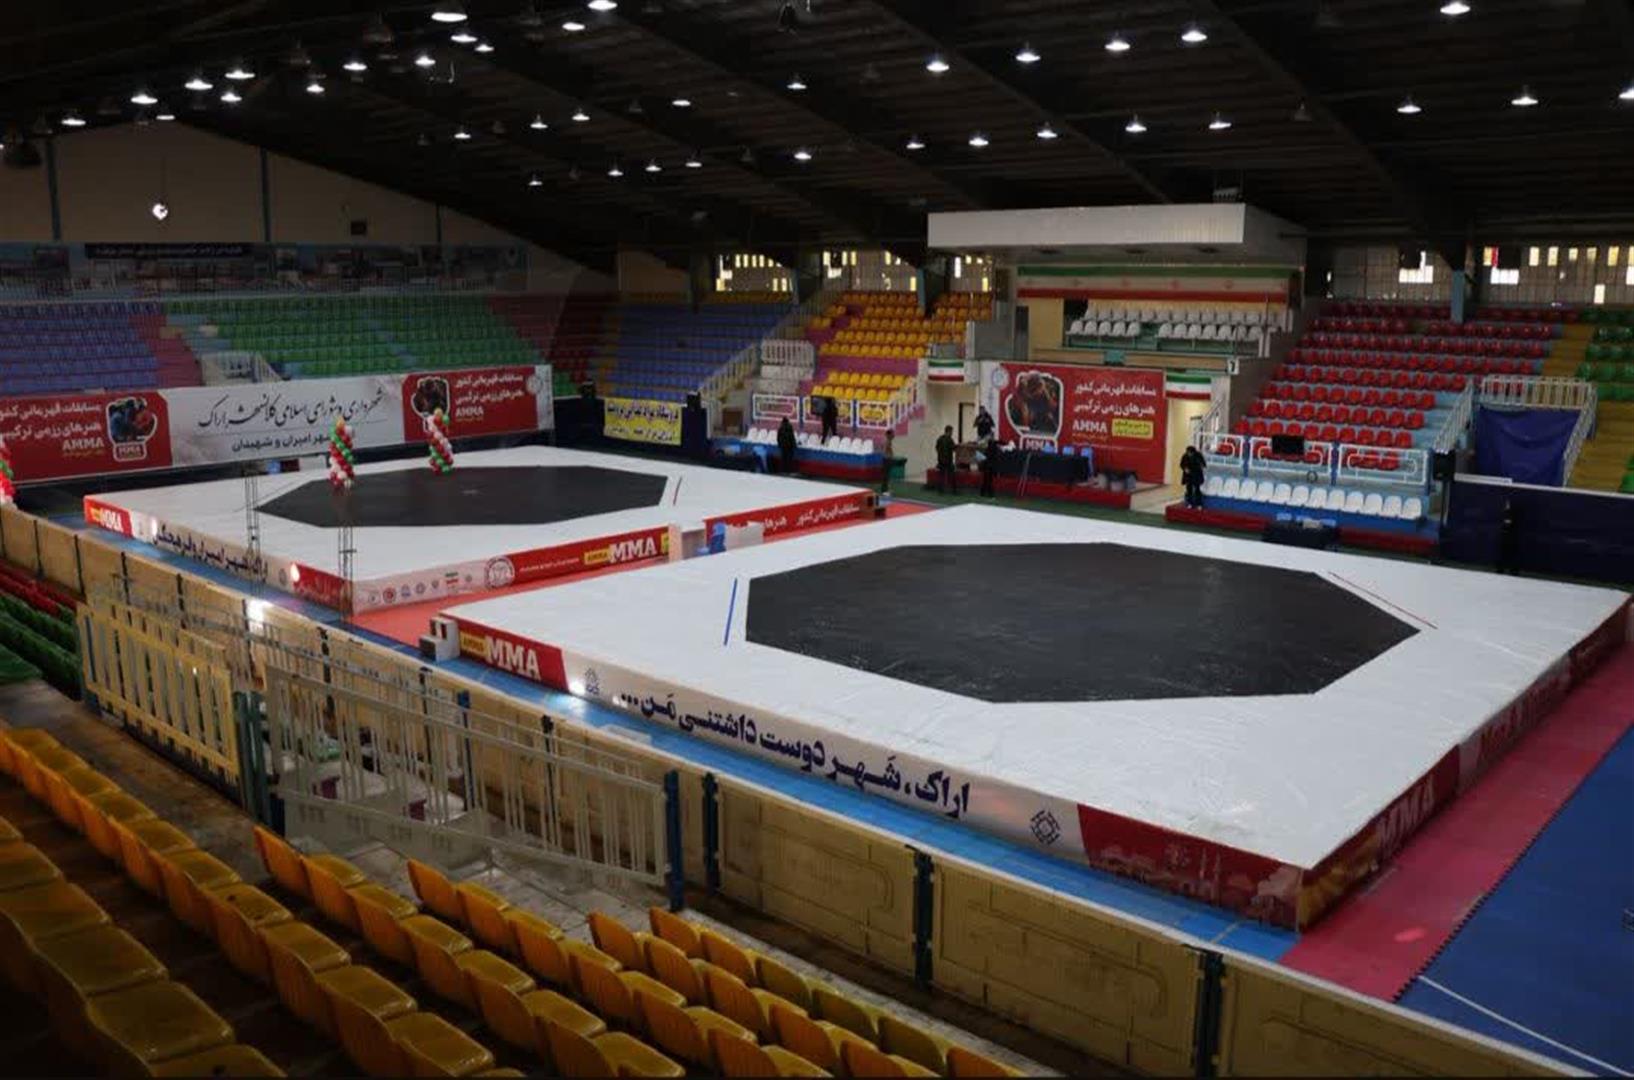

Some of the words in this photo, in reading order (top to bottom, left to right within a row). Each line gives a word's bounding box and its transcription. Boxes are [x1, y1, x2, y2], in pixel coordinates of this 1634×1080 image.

[1074, 381, 1094, 394] کشور
[1093, 383, 1124, 397] قهرمانی
[1124, 384, 1156, 396] مسابقات
[1072, 419, 1107, 433] AMMA
[62, 437, 104, 451] AMMA
[608, 536, 658, 563] MMA
[484, 635, 542, 682] MMA
[679, 708, 757, 745] داشتنی
[759, 732, 826, 772] دوست
